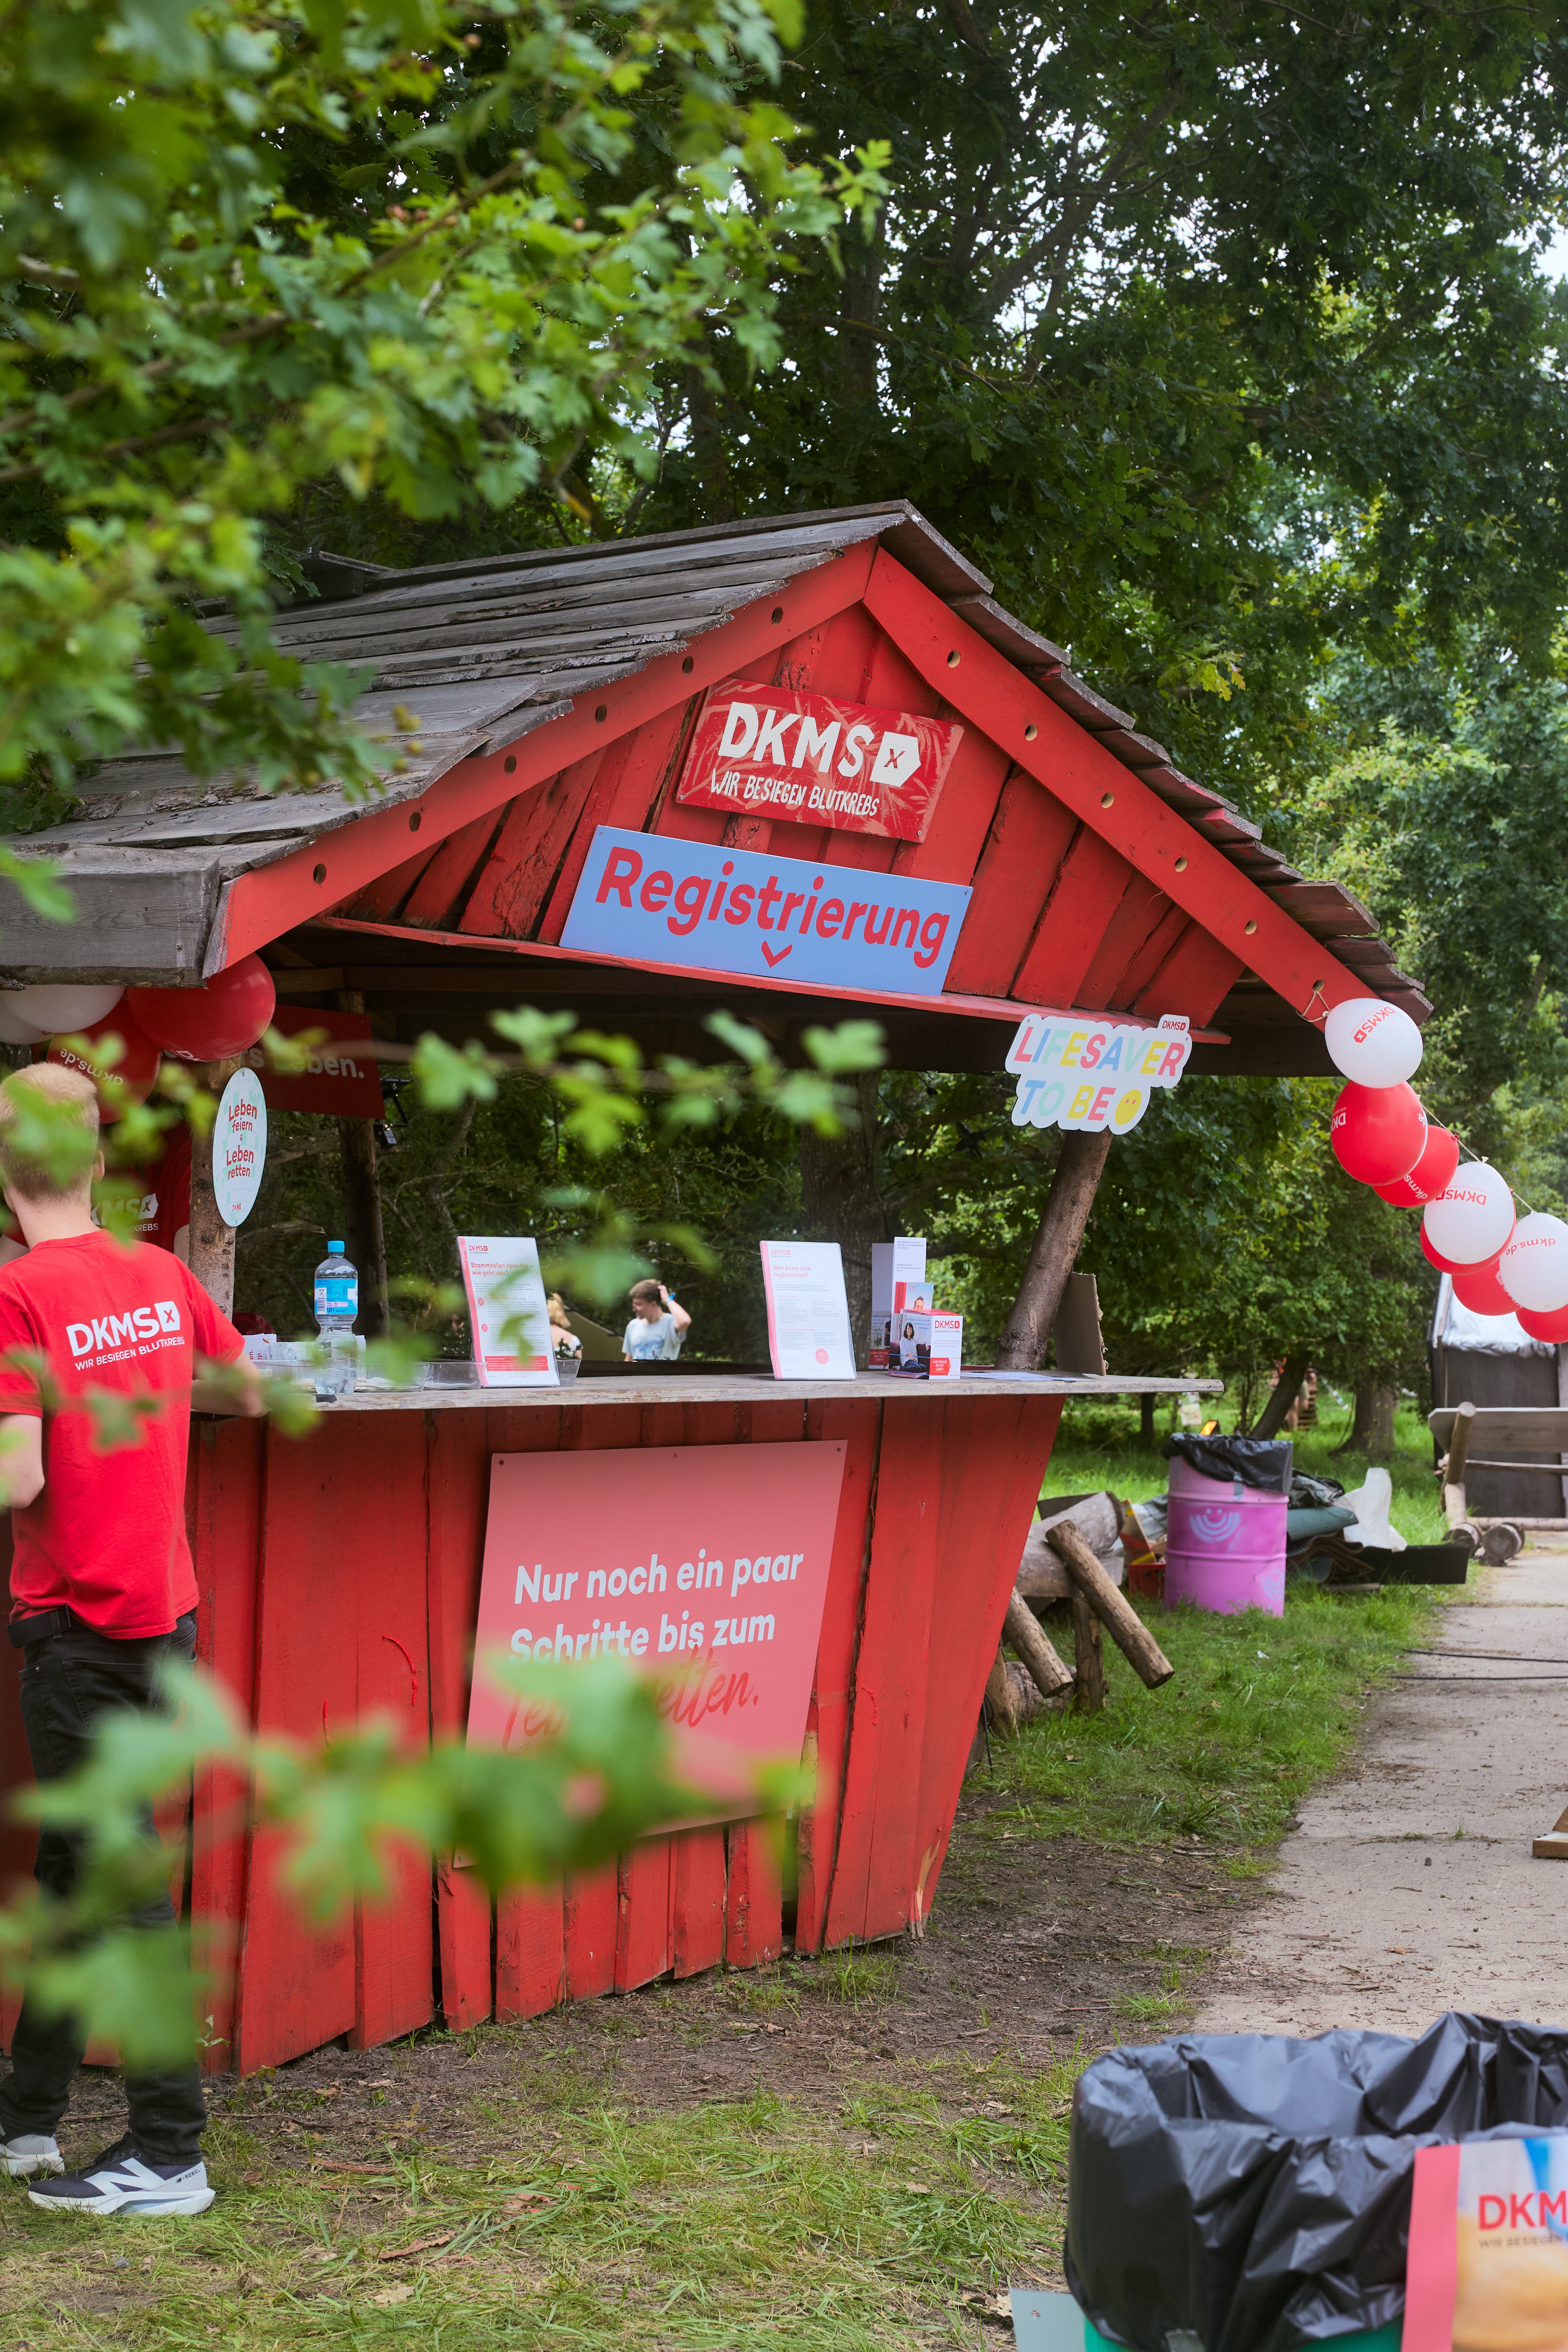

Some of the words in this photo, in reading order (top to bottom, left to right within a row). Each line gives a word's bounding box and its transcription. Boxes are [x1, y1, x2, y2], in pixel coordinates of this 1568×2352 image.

[718, 701, 874, 777] DKMS
[710, 768, 740, 796] WIR
[744, 775, 807, 806] BESIEGEN
[808, 785, 880, 816] BLUTKREBS
[595, 846, 950, 969] Registrierung
[1162, 1020, 1180, 1030] DKMS
[1362, 1006, 1395, 1033] DKMS
[1014, 1027, 1185, 1077] LIFESAVER
[229, 1099, 257, 1122] Leben
[1020, 1079, 1065, 1117] TO
[1067, 1085, 1116, 1121] BE
[232, 1117, 252, 1133] feiern
[227, 1145, 254, 1166] Leben
[228, 1164, 250, 1180] retten
[1446, 1189, 1487, 1206] DKMS
[1505, 1238, 1556, 1255] dkms.de
[66, 1307, 160, 1356] DKMS
[935, 1320, 954, 1329] DKMS
[75, 1359, 94, 1371] WIR
[96, 1348, 136, 1366] BESIEGEN
[138, 1336, 185, 1355] BLUTKREBS
[514, 1564, 579, 1605] Nur
[586, 1554, 667, 1598] noch
[676, 1548, 724, 1590] ein
[731, 1553, 804, 1597] paar
[508, 1618, 649, 1665] Schritte
[658, 1610, 705, 1653] bis
[712, 1613, 776, 1647] zum
[185, 2168, 201, 2179] REBEL
[1478, 2190, 1567, 2230] DKM
